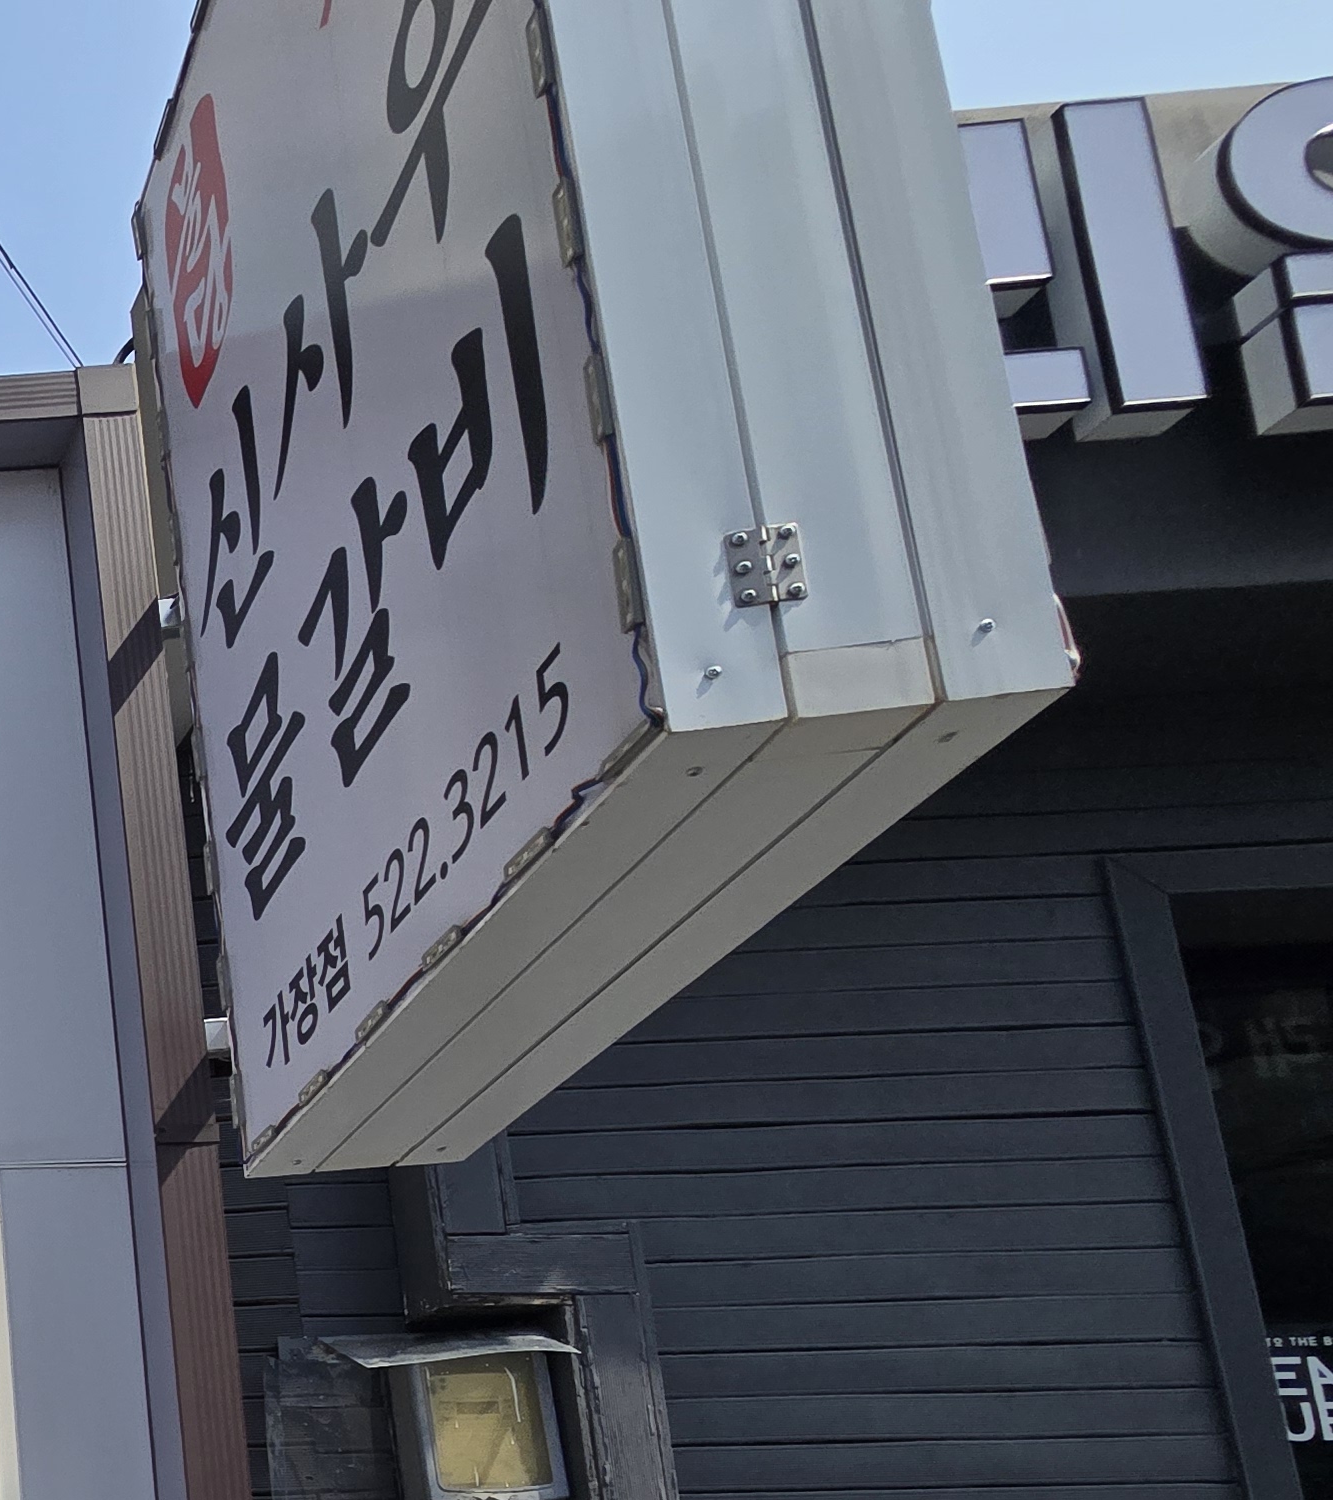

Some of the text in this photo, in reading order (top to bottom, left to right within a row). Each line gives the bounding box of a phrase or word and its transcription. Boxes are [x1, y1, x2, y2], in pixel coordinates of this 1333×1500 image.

[226, 213, 549, 921] 물갈비
[263, 642, 569, 1067] 가장점 522.3215
